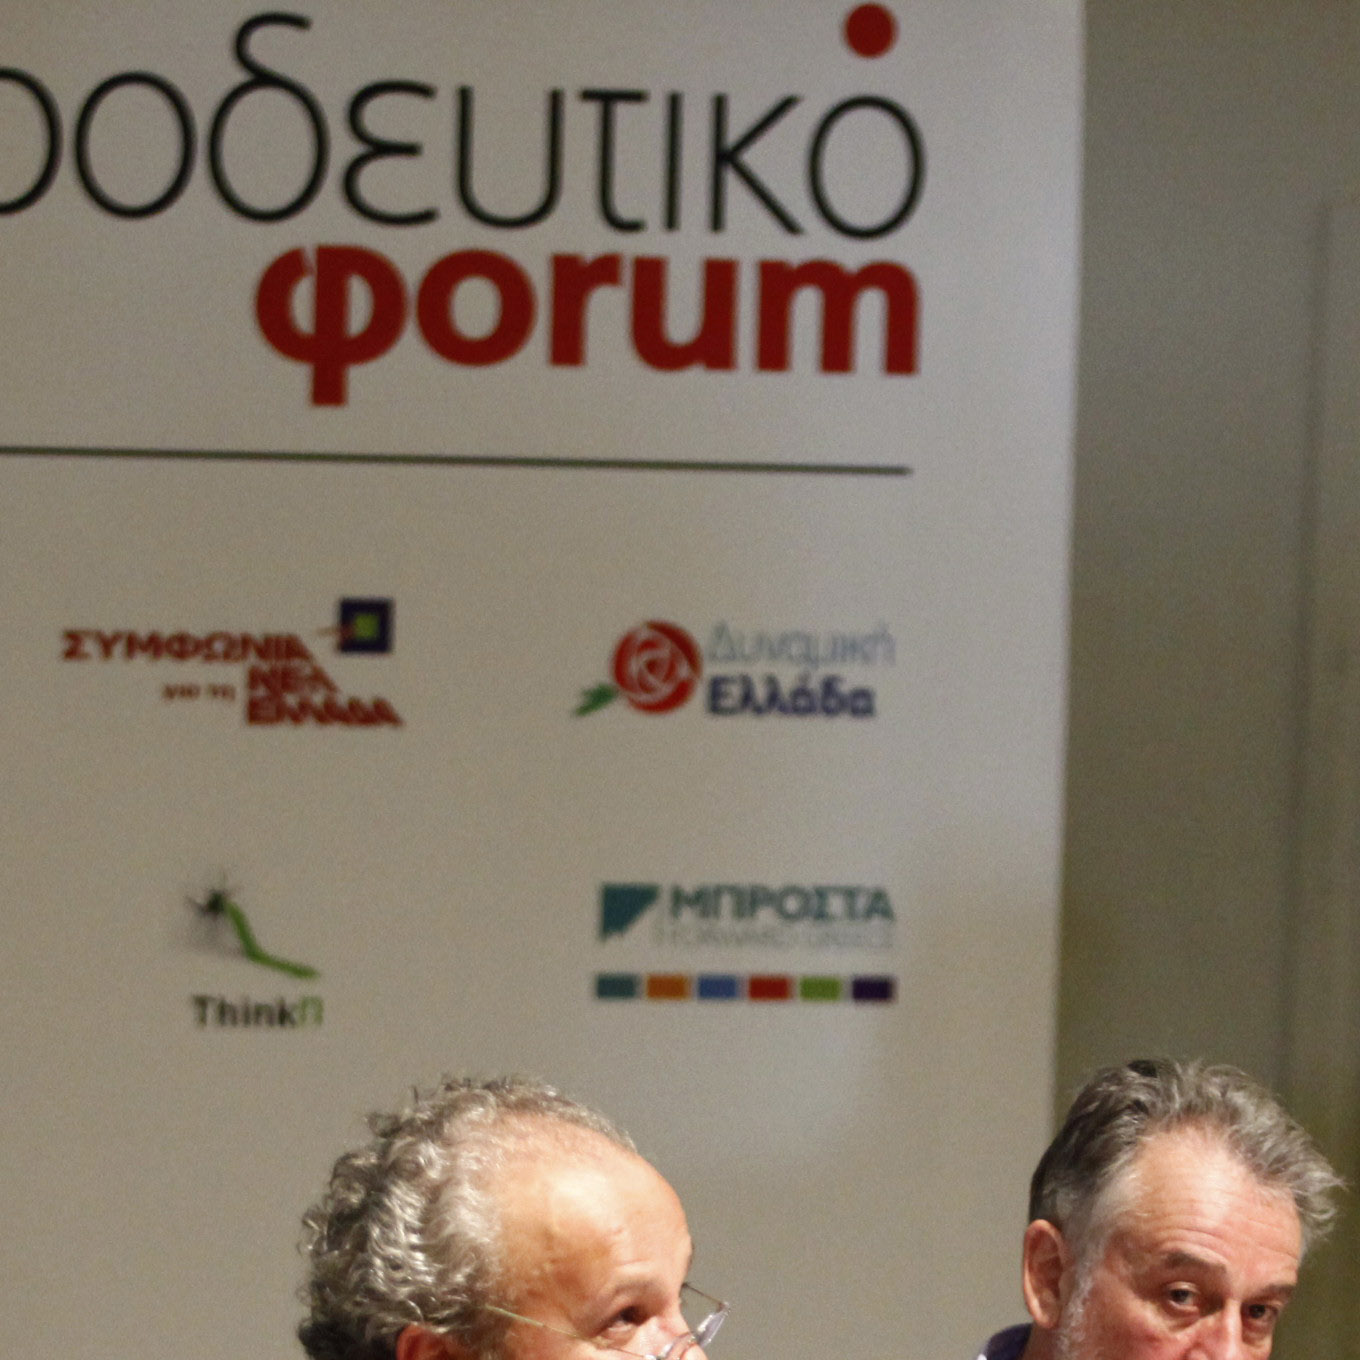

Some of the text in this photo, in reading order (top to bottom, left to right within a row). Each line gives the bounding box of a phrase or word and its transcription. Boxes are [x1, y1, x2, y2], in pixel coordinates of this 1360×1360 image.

[61, 628, 316, 664] ΣΥΜΦΩΝΙΑ
[246, 663, 340, 696] ΝΕΑ
[705, 668, 876, 720] Ελλάδα
[667, 882, 896, 923] ΜΠΡΟΣΤΑ
